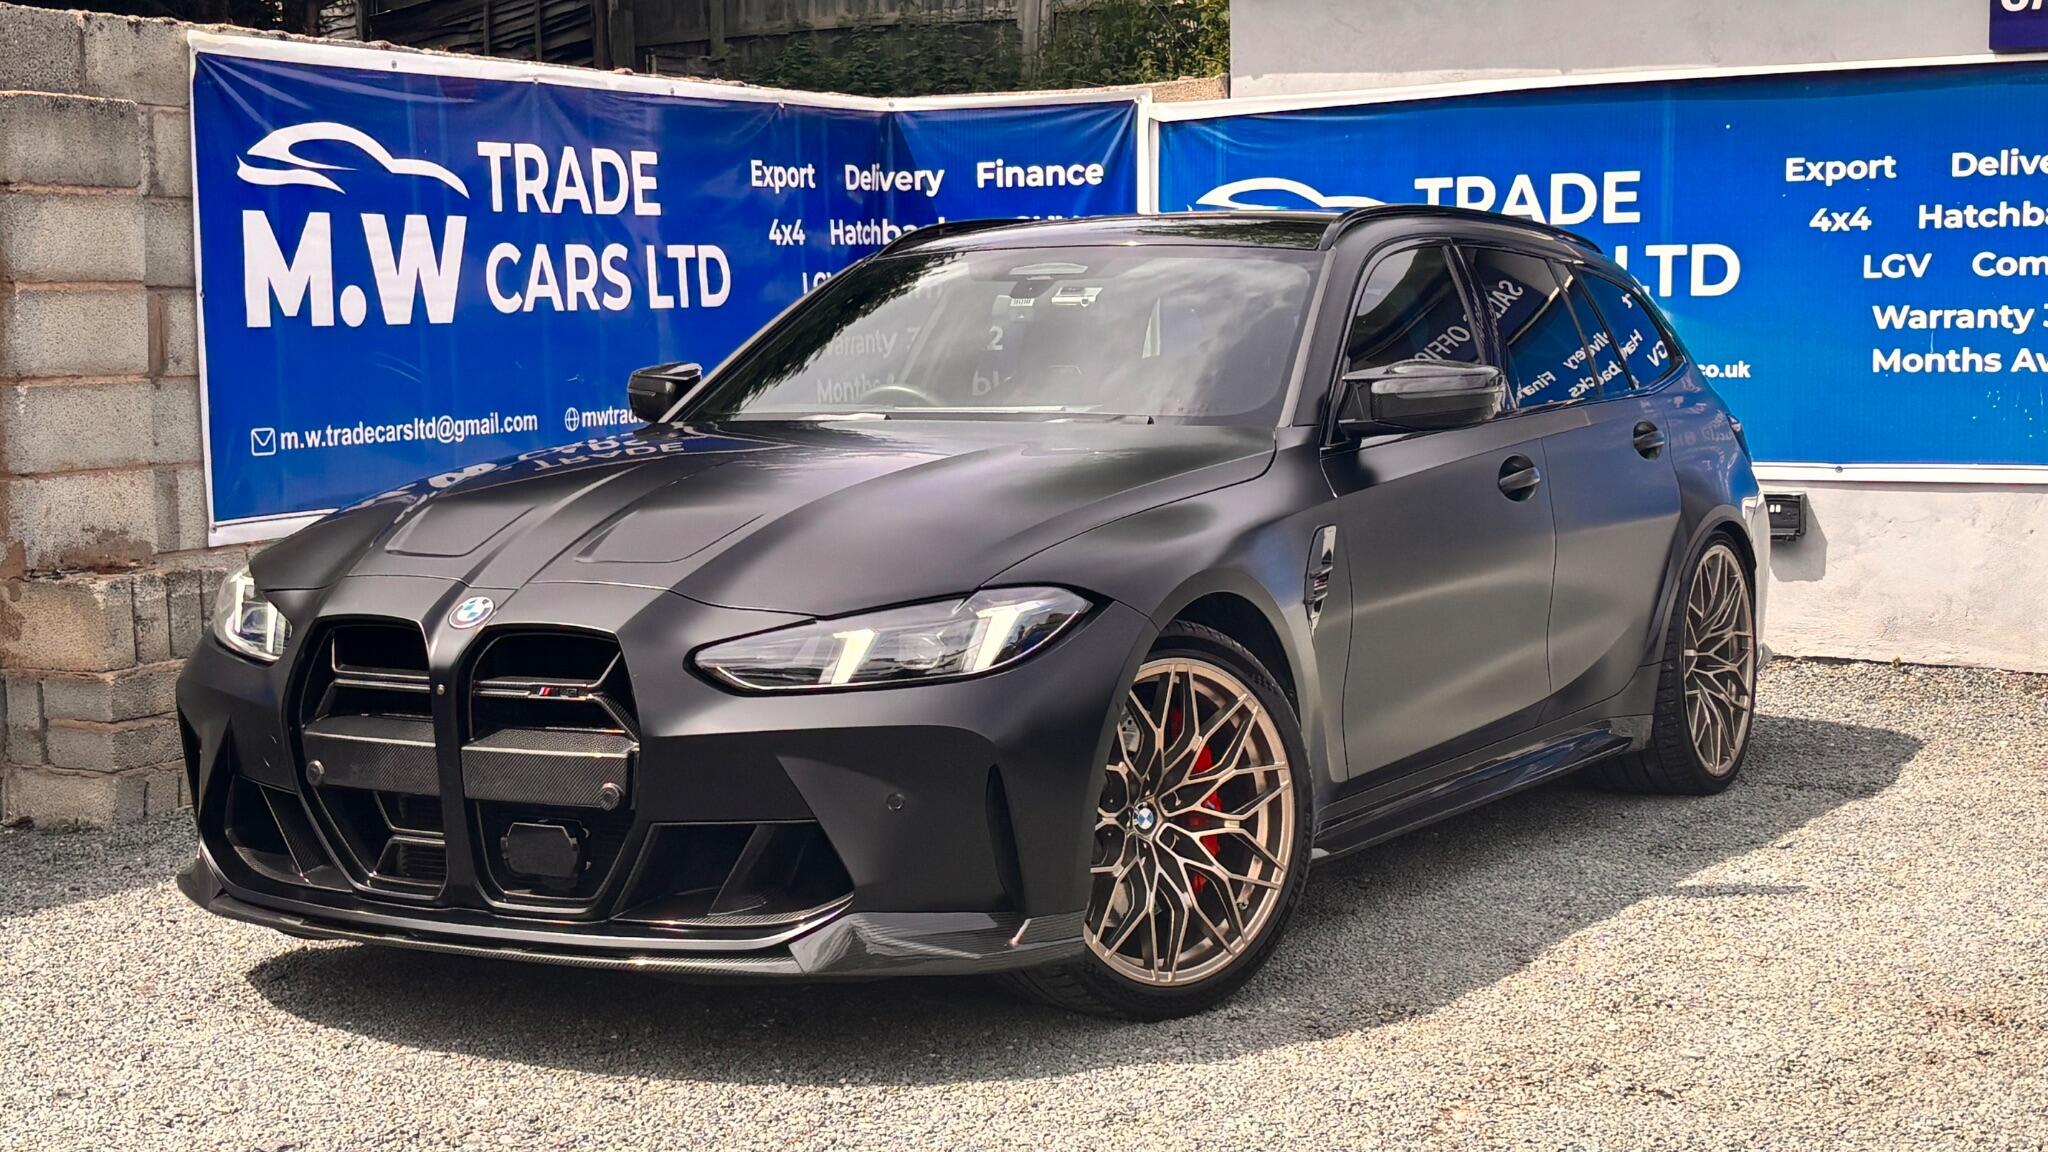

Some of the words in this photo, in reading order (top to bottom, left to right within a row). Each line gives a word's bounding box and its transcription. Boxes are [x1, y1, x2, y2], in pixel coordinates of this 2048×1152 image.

[477, 141, 662, 216] TRADE
[750, 159, 816, 194] Export
[844, 163, 945, 197] Delivery
[976, 158, 1104, 189] Finance
[1785, 155, 1897, 187] Export
[1809, 206, 1872, 232] 4x4
[1918, 200, 2048, 229] Hatchb
[768, 219, 806, 246] 4x4
[242, 209, 467, 328] M.W
[485, 242, 632, 314] CARS
[646, 244, 731, 309] LTD
[1863, 253, 1932, 279] LGV
[1872, 305, 2035, 335] Warranty
[1872, 346, 2002, 373] Months
[280, 412, 538, 451] m.w.tradecarsltd@gmail.com
